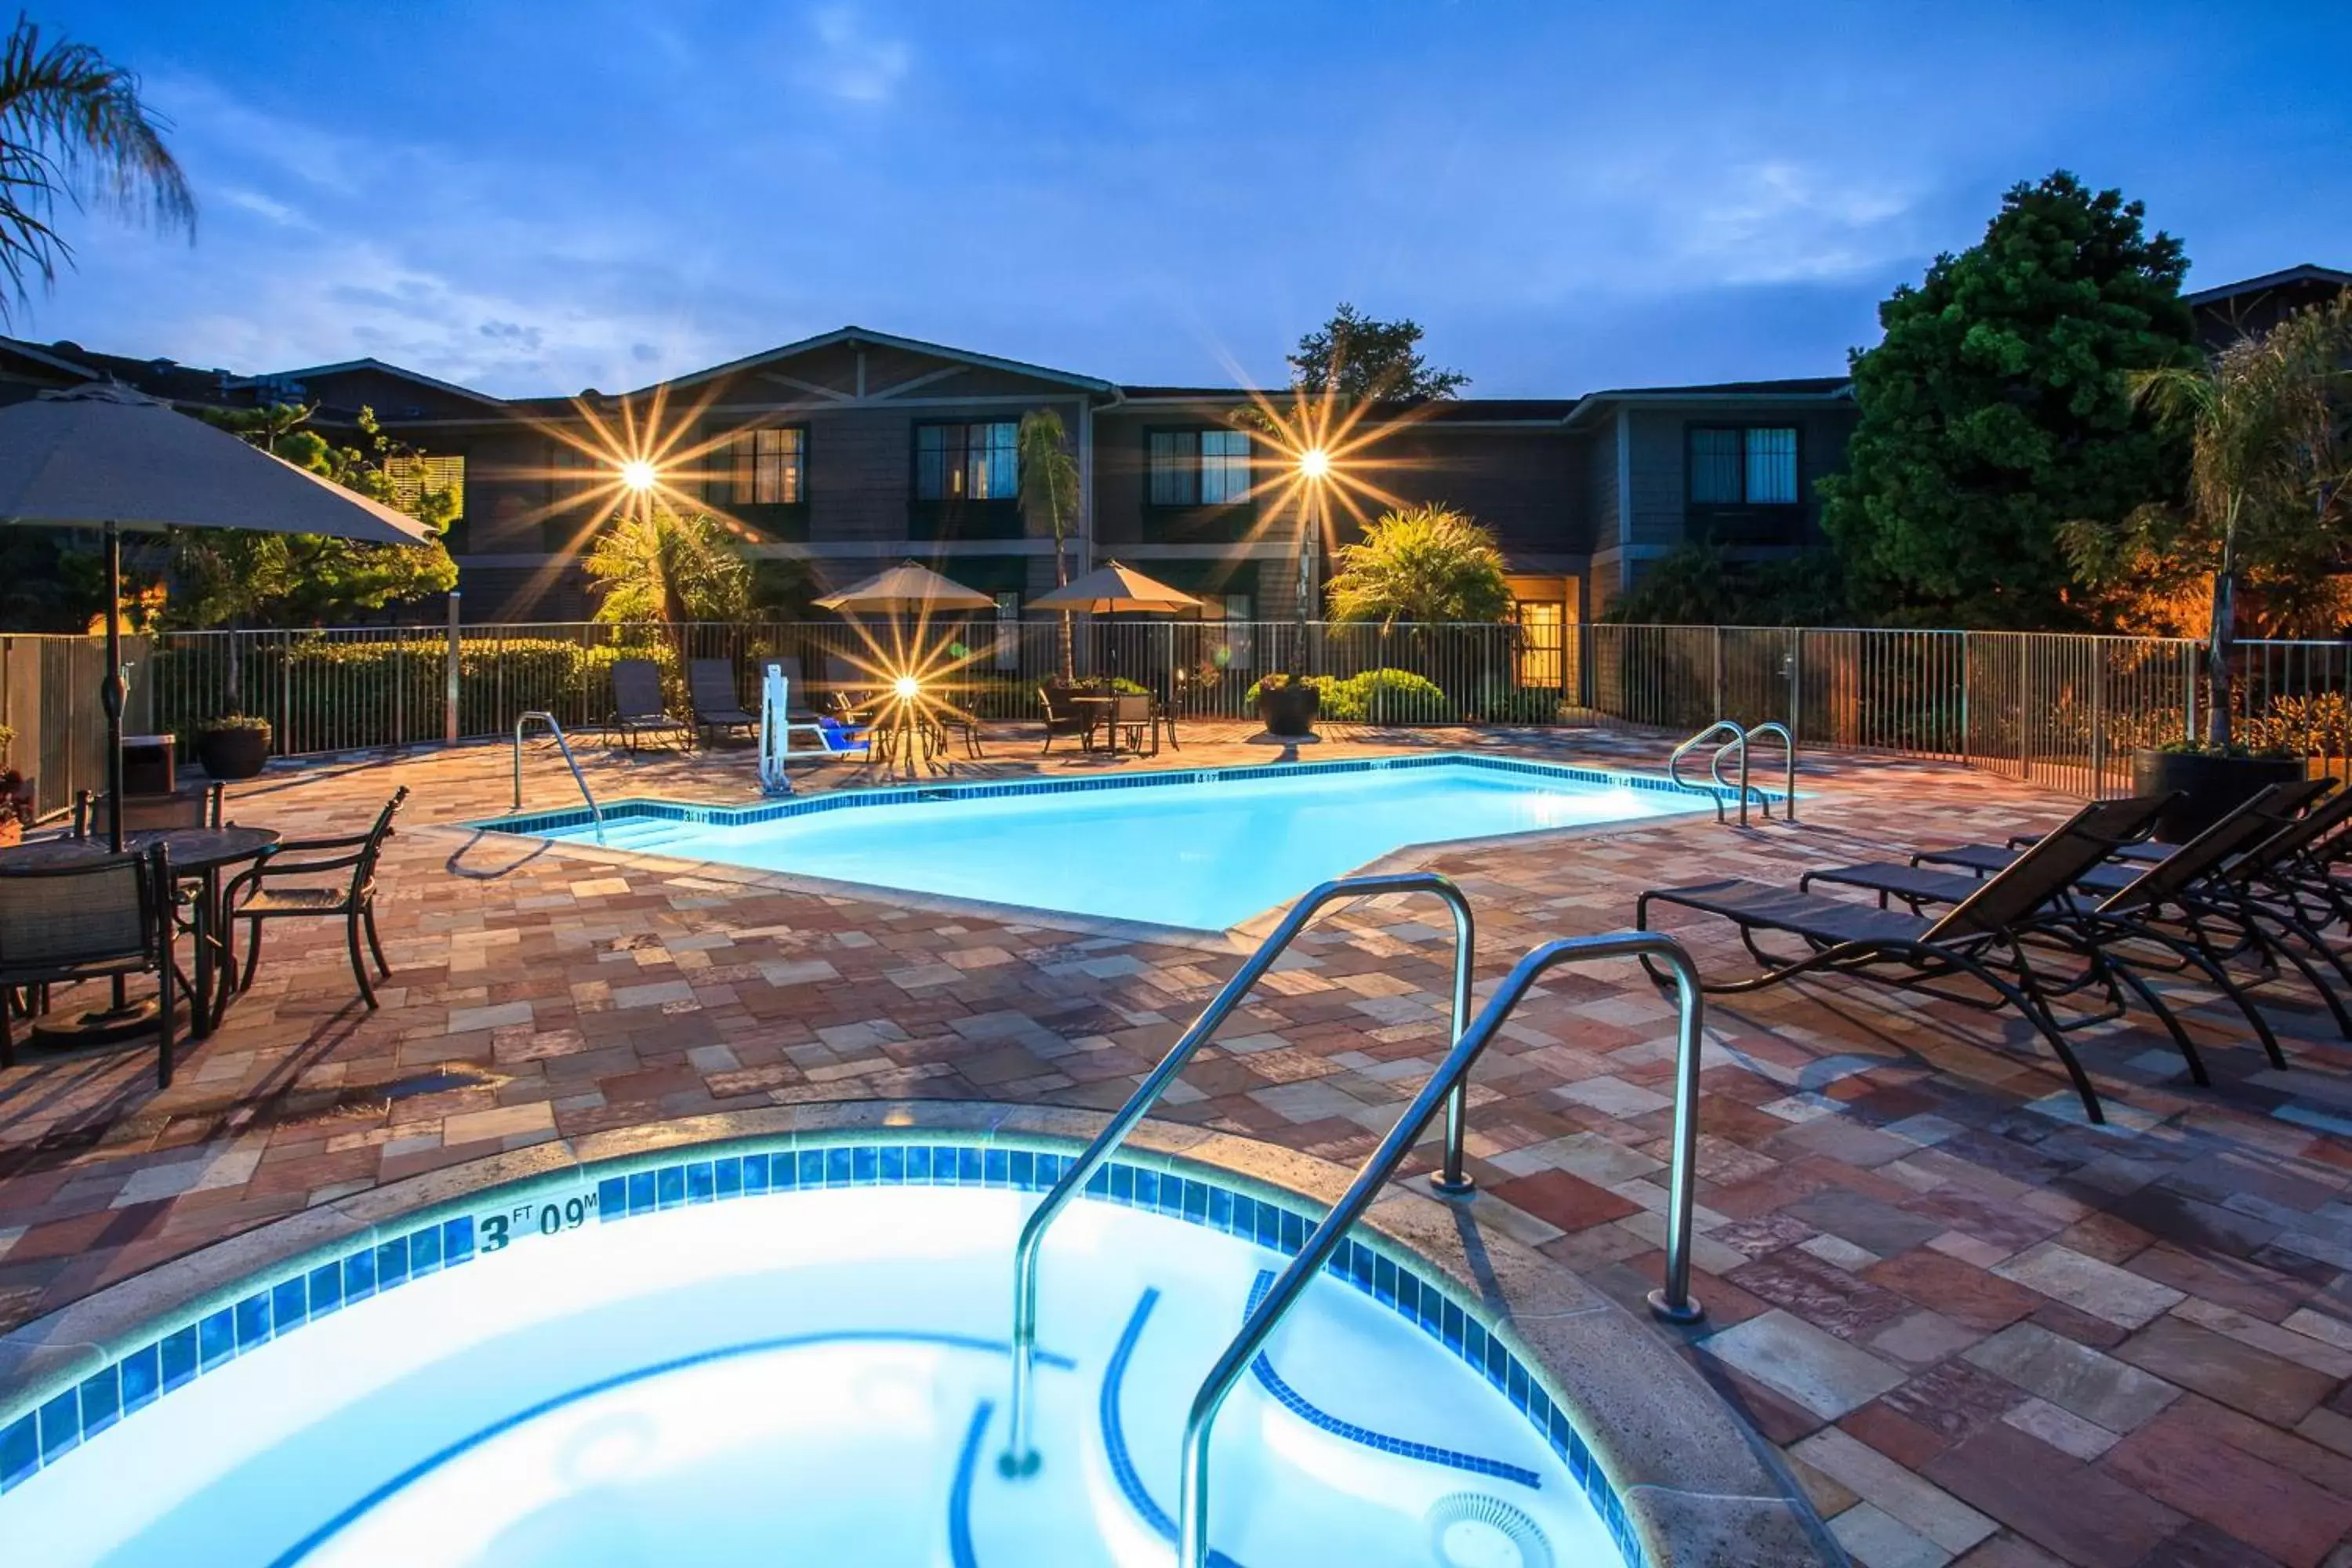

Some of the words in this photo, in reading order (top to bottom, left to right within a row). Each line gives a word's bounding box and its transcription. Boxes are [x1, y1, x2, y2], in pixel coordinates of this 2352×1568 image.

[480, 1215, 509, 1254] 3
[514, 1205, 533, 1223] FT
[584, 1192, 597, 1209] M
